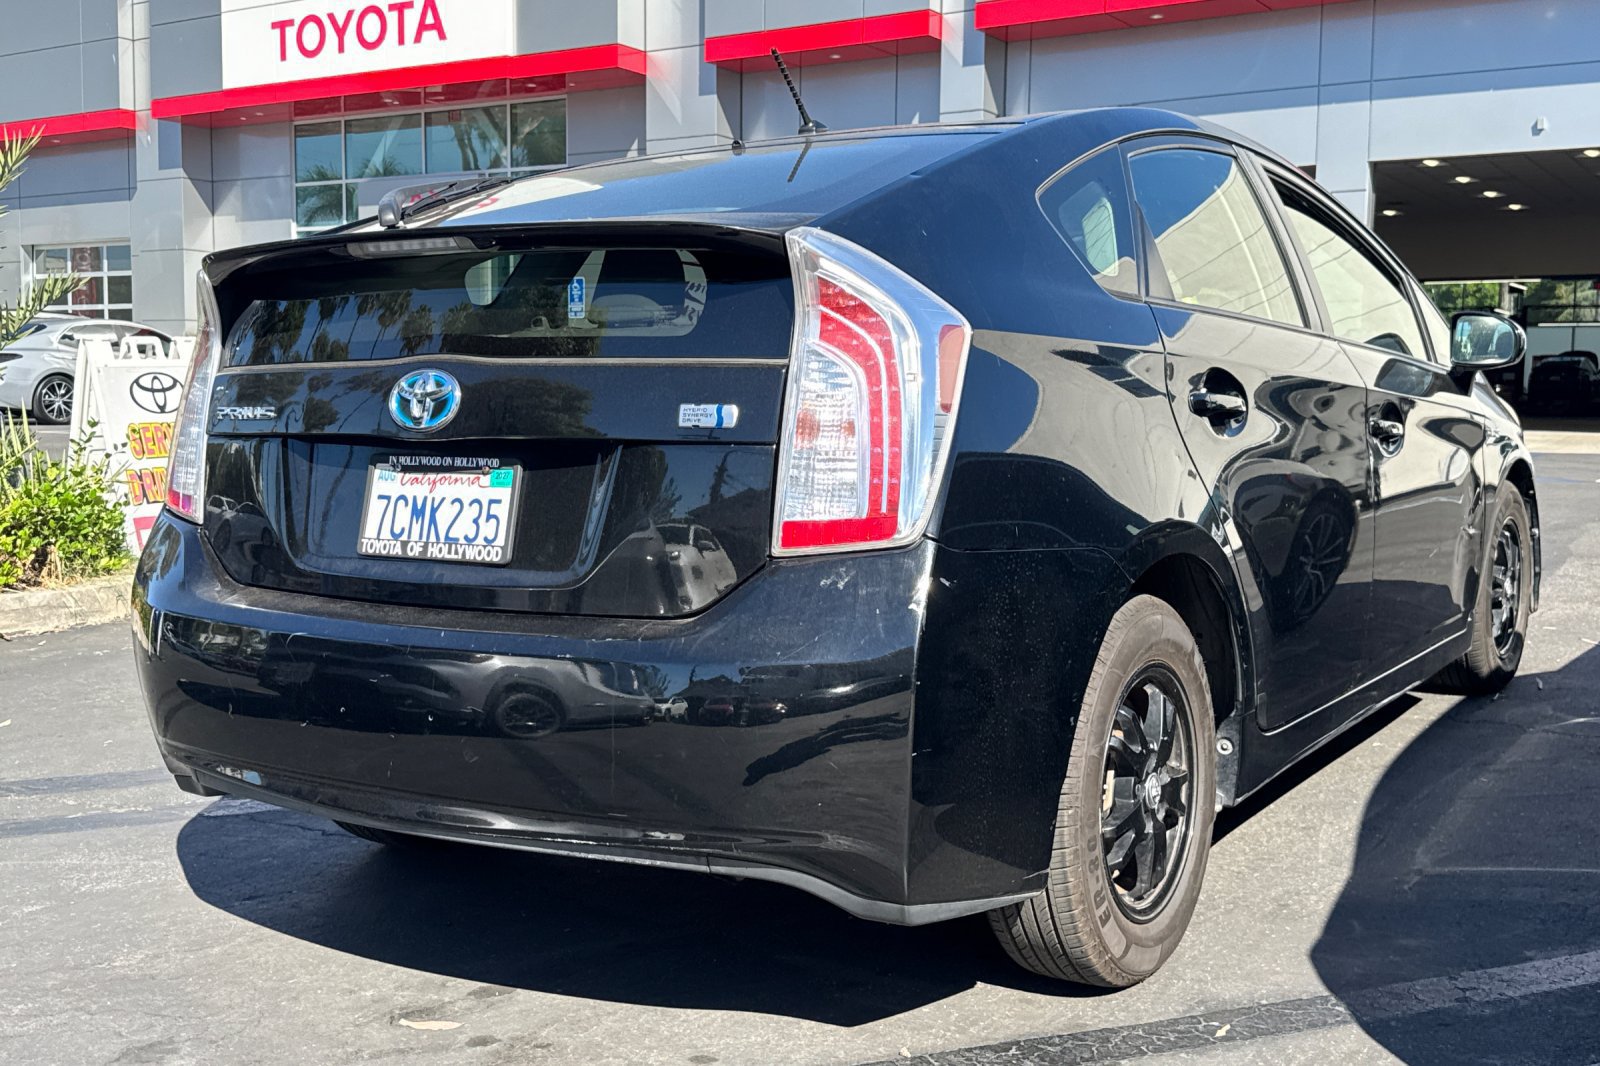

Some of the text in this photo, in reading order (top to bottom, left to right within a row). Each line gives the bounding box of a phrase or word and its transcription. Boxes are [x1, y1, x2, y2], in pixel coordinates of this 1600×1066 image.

[271, 0, 447, 61] TOYOTA
[217, 406, 277, 420] PRIUS
[389, 455, 500, 468] IN HOLLYWOOD ON HOLLYWOOD
[377, 470, 396, 481] AUG
[400, 472, 490, 494] California
[494, 471, 510, 480] 2027
[376, 494, 502, 545] 7CMK235
[361, 538, 503, 562] TOYOTA OF HOLLYWOOD
